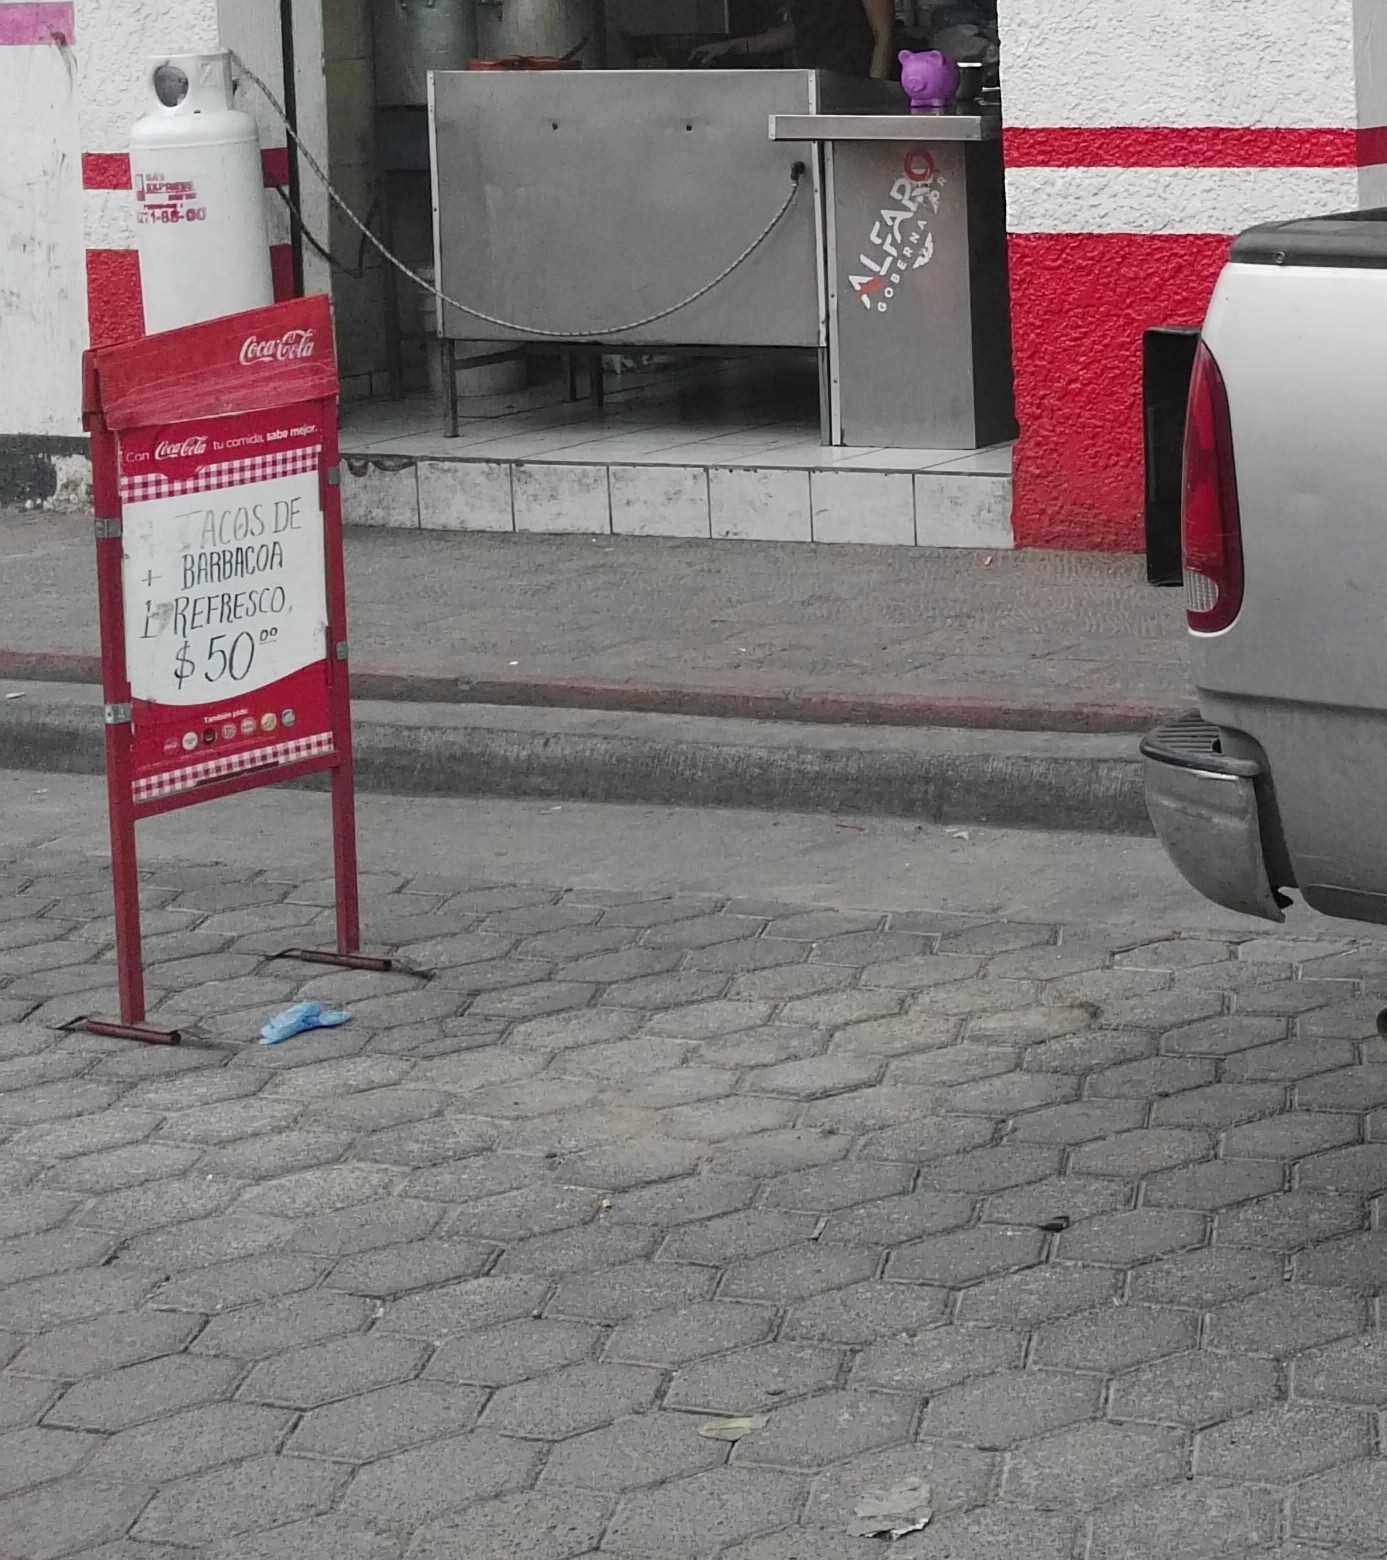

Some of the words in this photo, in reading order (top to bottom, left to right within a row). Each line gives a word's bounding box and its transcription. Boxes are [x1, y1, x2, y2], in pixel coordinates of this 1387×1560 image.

[239, 328, 314, 366] Coca-Cola
[125, 450, 150, 463] Con
[212, 439, 225, 451] tu
[266, 429, 288, 442] sabe
[272, 496, 302, 534] DE
[180, 541, 284, 591] BARBACOA
